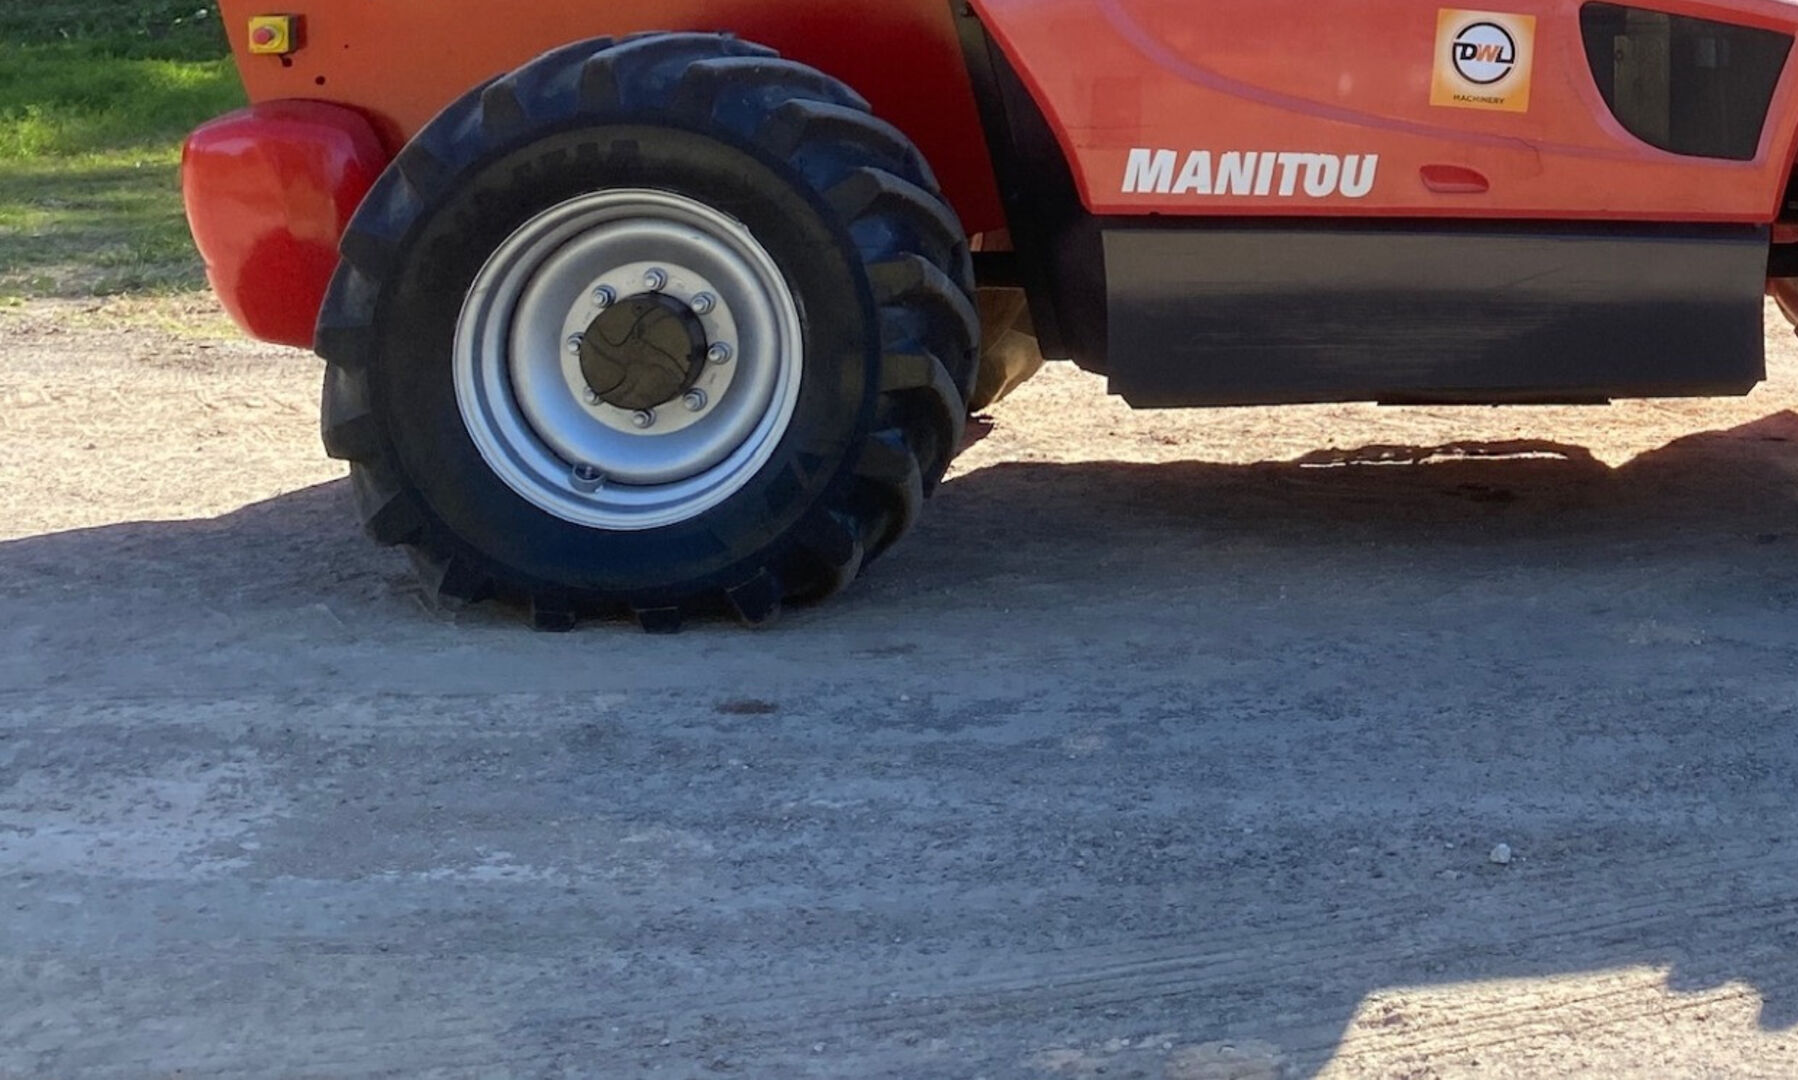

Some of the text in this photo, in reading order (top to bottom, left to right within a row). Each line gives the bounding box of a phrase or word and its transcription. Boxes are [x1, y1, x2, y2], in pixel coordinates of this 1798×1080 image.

[1455, 42, 1513, 64] DWL
[1453, 94, 1506, 104] MACHINERY
[1121, 148, 1379, 198] MANITOU
